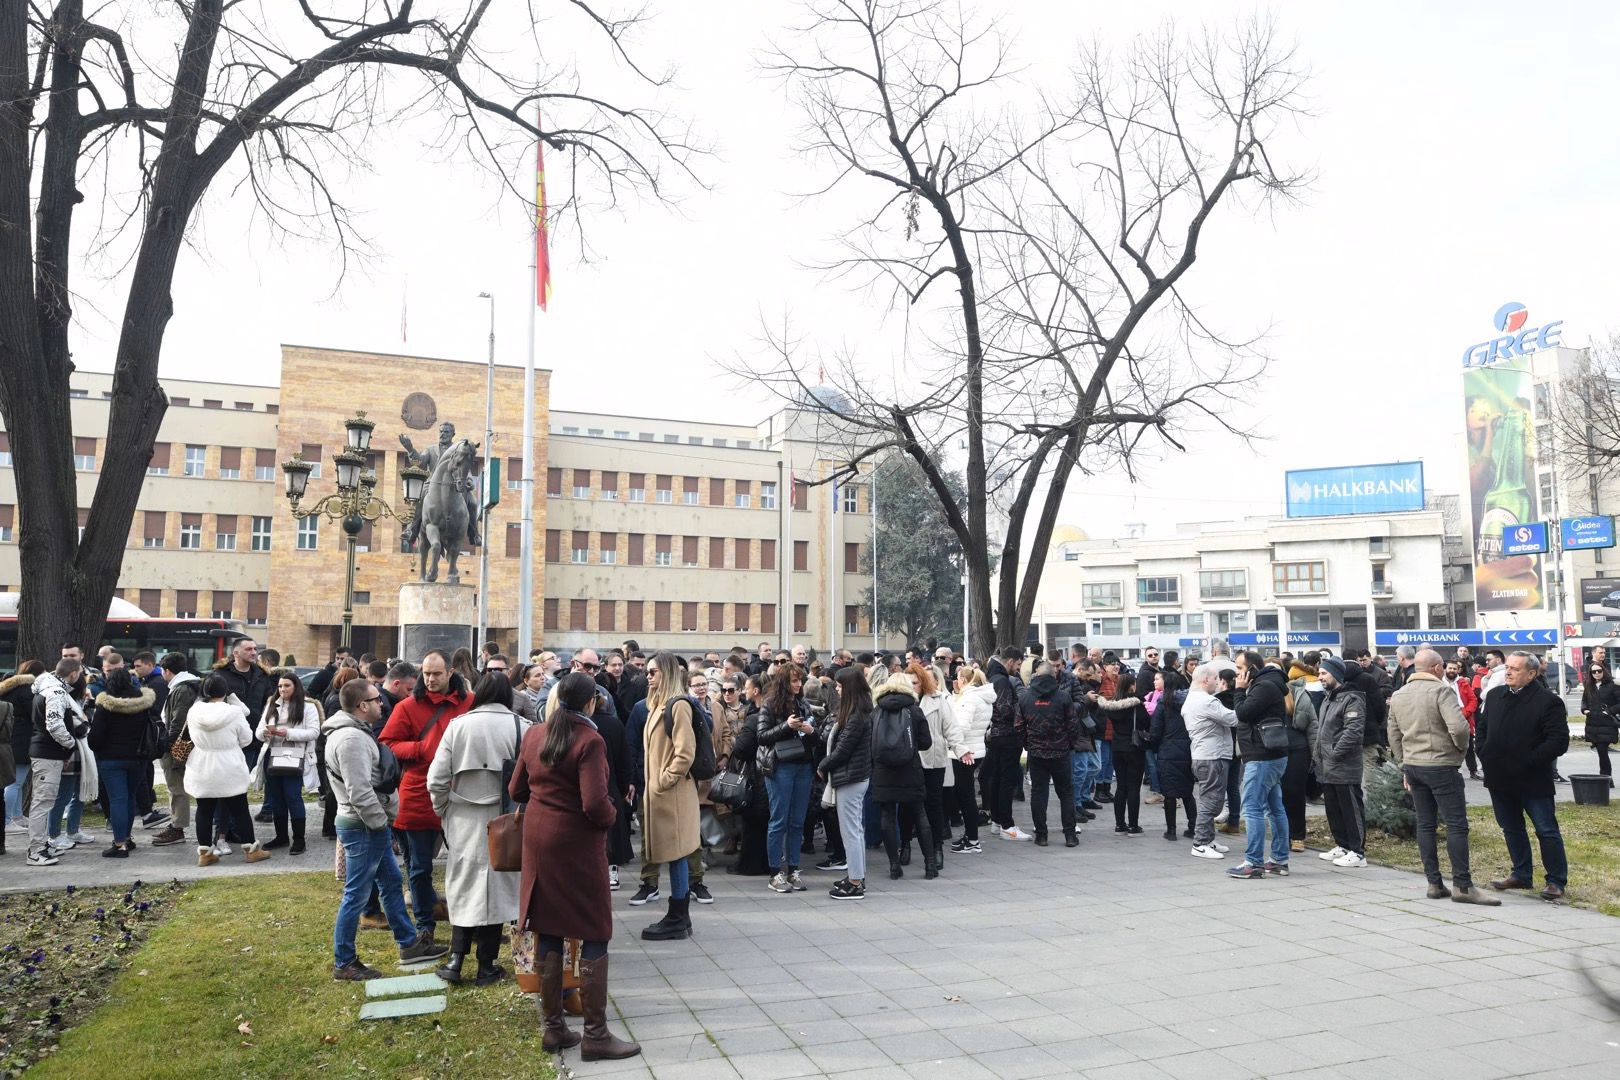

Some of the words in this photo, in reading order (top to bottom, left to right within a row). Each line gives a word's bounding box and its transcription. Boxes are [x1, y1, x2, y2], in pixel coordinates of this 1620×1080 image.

[1462, 320, 1563, 368] GREE
[1314, 478, 1418, 498] HALKBANK
[1266, 634, 1310, 642] HABANK
[1409, 633, 1460, 642] HALKBANK
